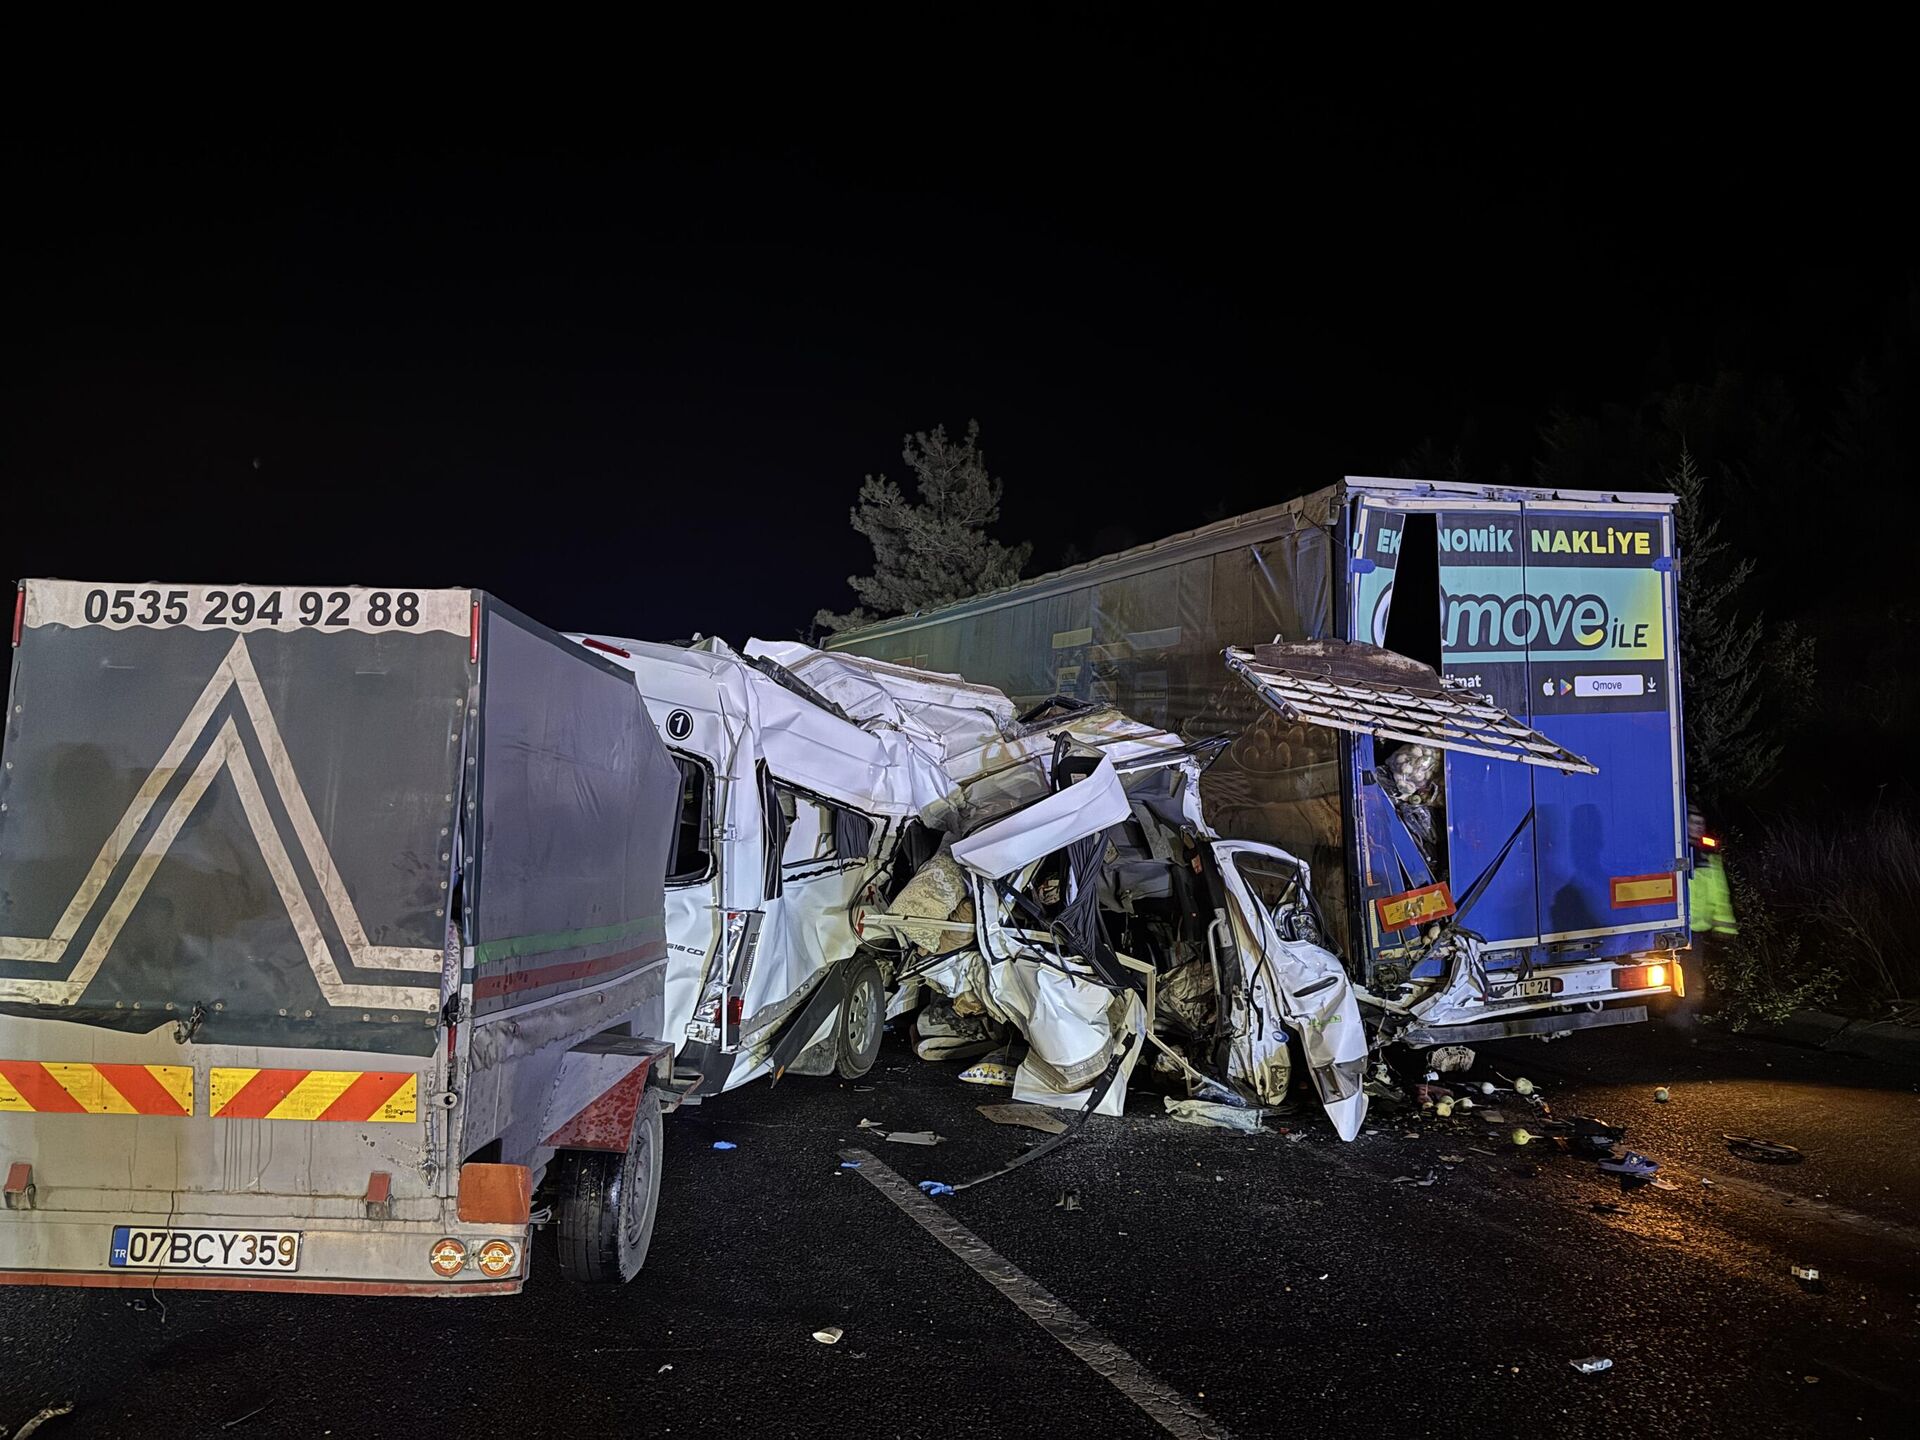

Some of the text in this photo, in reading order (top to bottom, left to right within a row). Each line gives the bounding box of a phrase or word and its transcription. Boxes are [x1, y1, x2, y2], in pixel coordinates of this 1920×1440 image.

[1376, 525, 1651, 555] EKNOMİK NAKLİYE
[84, 589, 420, 627] 0535 294 92 88
[1611, 618, 1649, 648] İLE
[1592, 680, 1622, 692] Qmove
[686, 947, 706, 957] CDI
[1537, 980, 1549, 994] 24
[114, 1249, 127, 1259] TR
